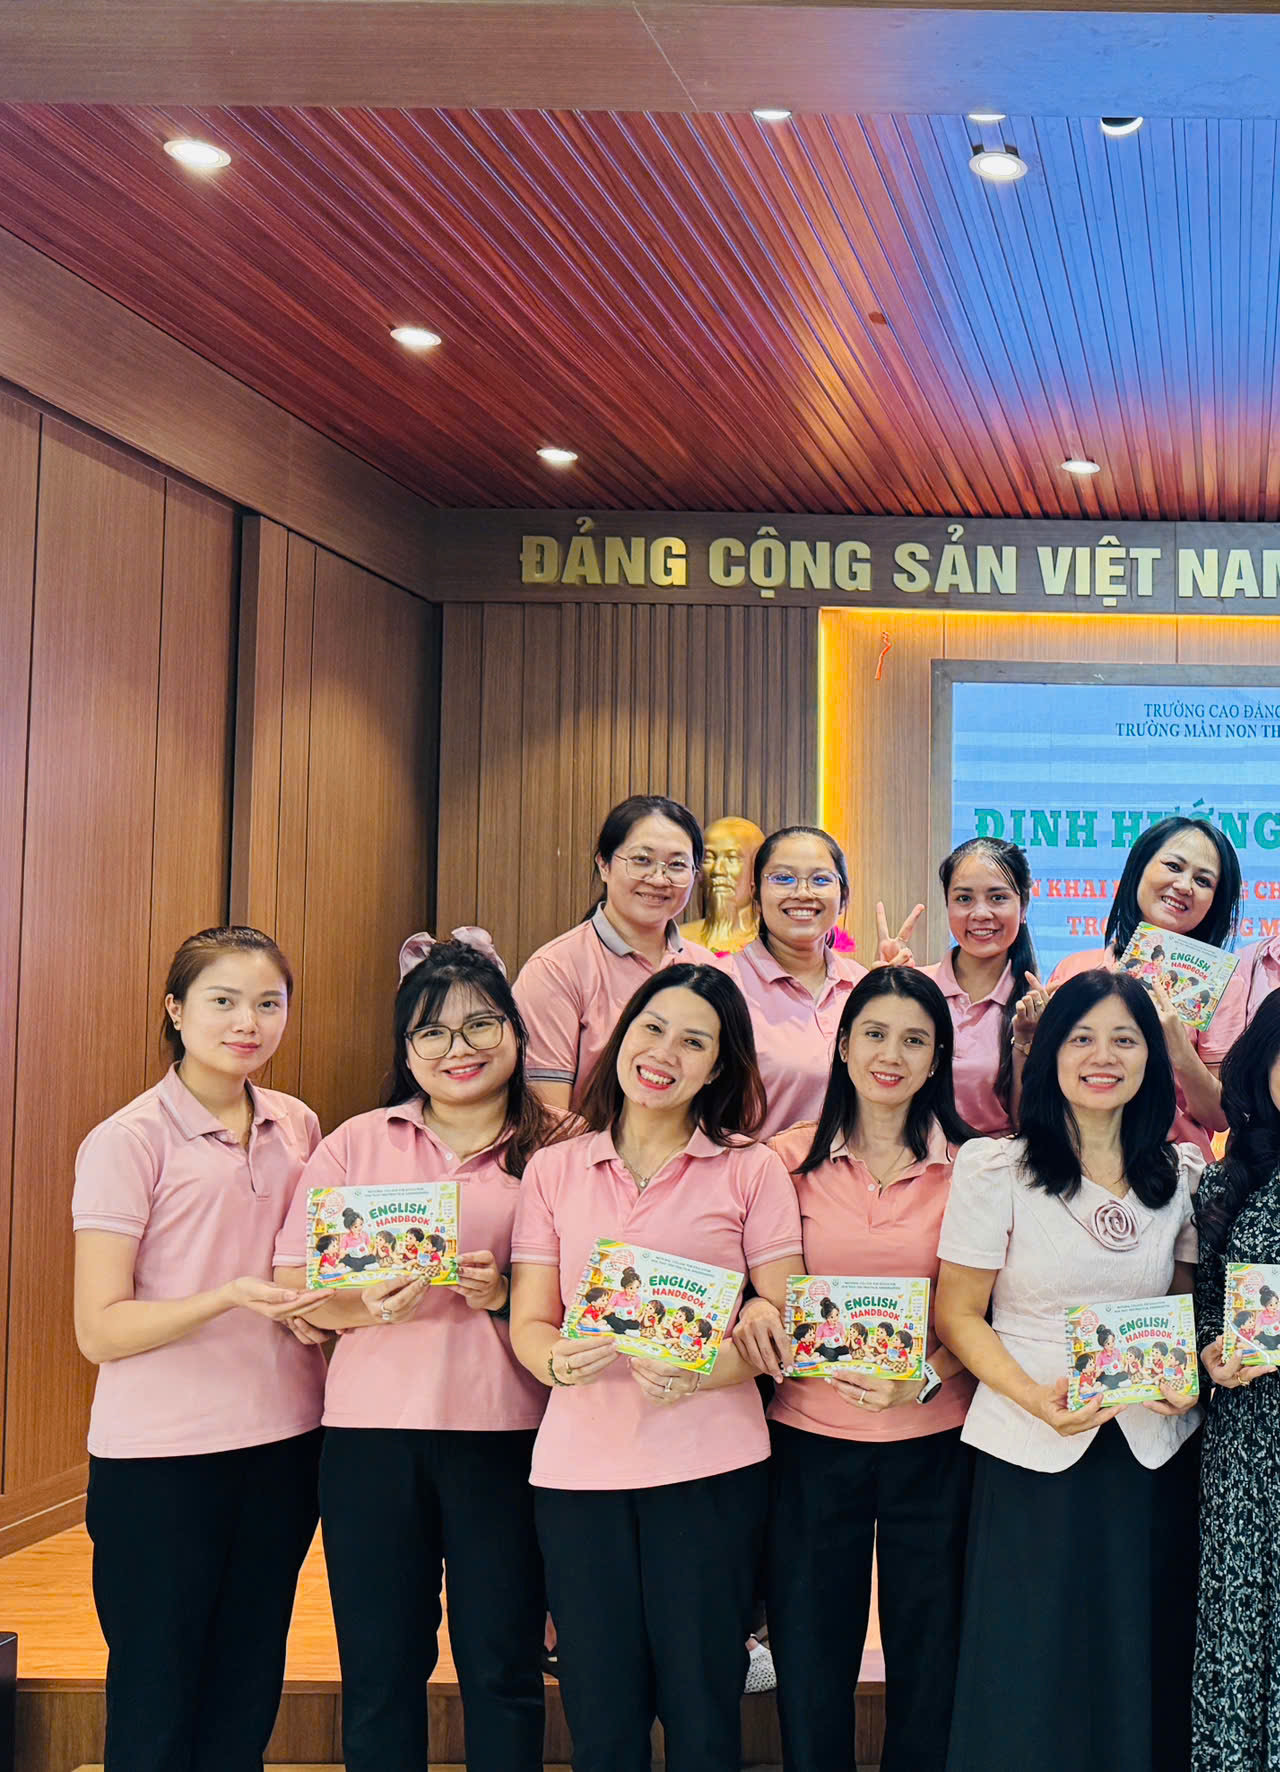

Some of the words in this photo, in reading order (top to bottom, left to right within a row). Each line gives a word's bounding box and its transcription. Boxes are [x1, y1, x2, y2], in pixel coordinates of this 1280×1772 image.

[520, 516, 689, 587] ĐẢNG
[709, 526, 873, 598] CỘNG
[894, 524, 1018, 595] SẢN
[1036, 535, 1162, 606] VIỆT
[1209, 703, 1239, 718] CAO
[1226, 724, 1257, 738] NON
[1047, 879, 1107, 898] KHAI
[1170, 952, 1211, 972] ENGLISH
[369, 1203, 428, 1220] ENGLISH
[376, 1215, 430, 1228] HANDBOOK
[649, 1275, 707, 1297] ENGLISH
[652, 1287, 706, 1309] HANDBOOK
[845, 1296, 898, 1311] ENGLISH
[850, 1308, 900, 1321] HANDBOOK
[1119, 1317, 1169, 1336] ENGLISH
[1125, 1329, 1172, 1344] HANDBOOK
